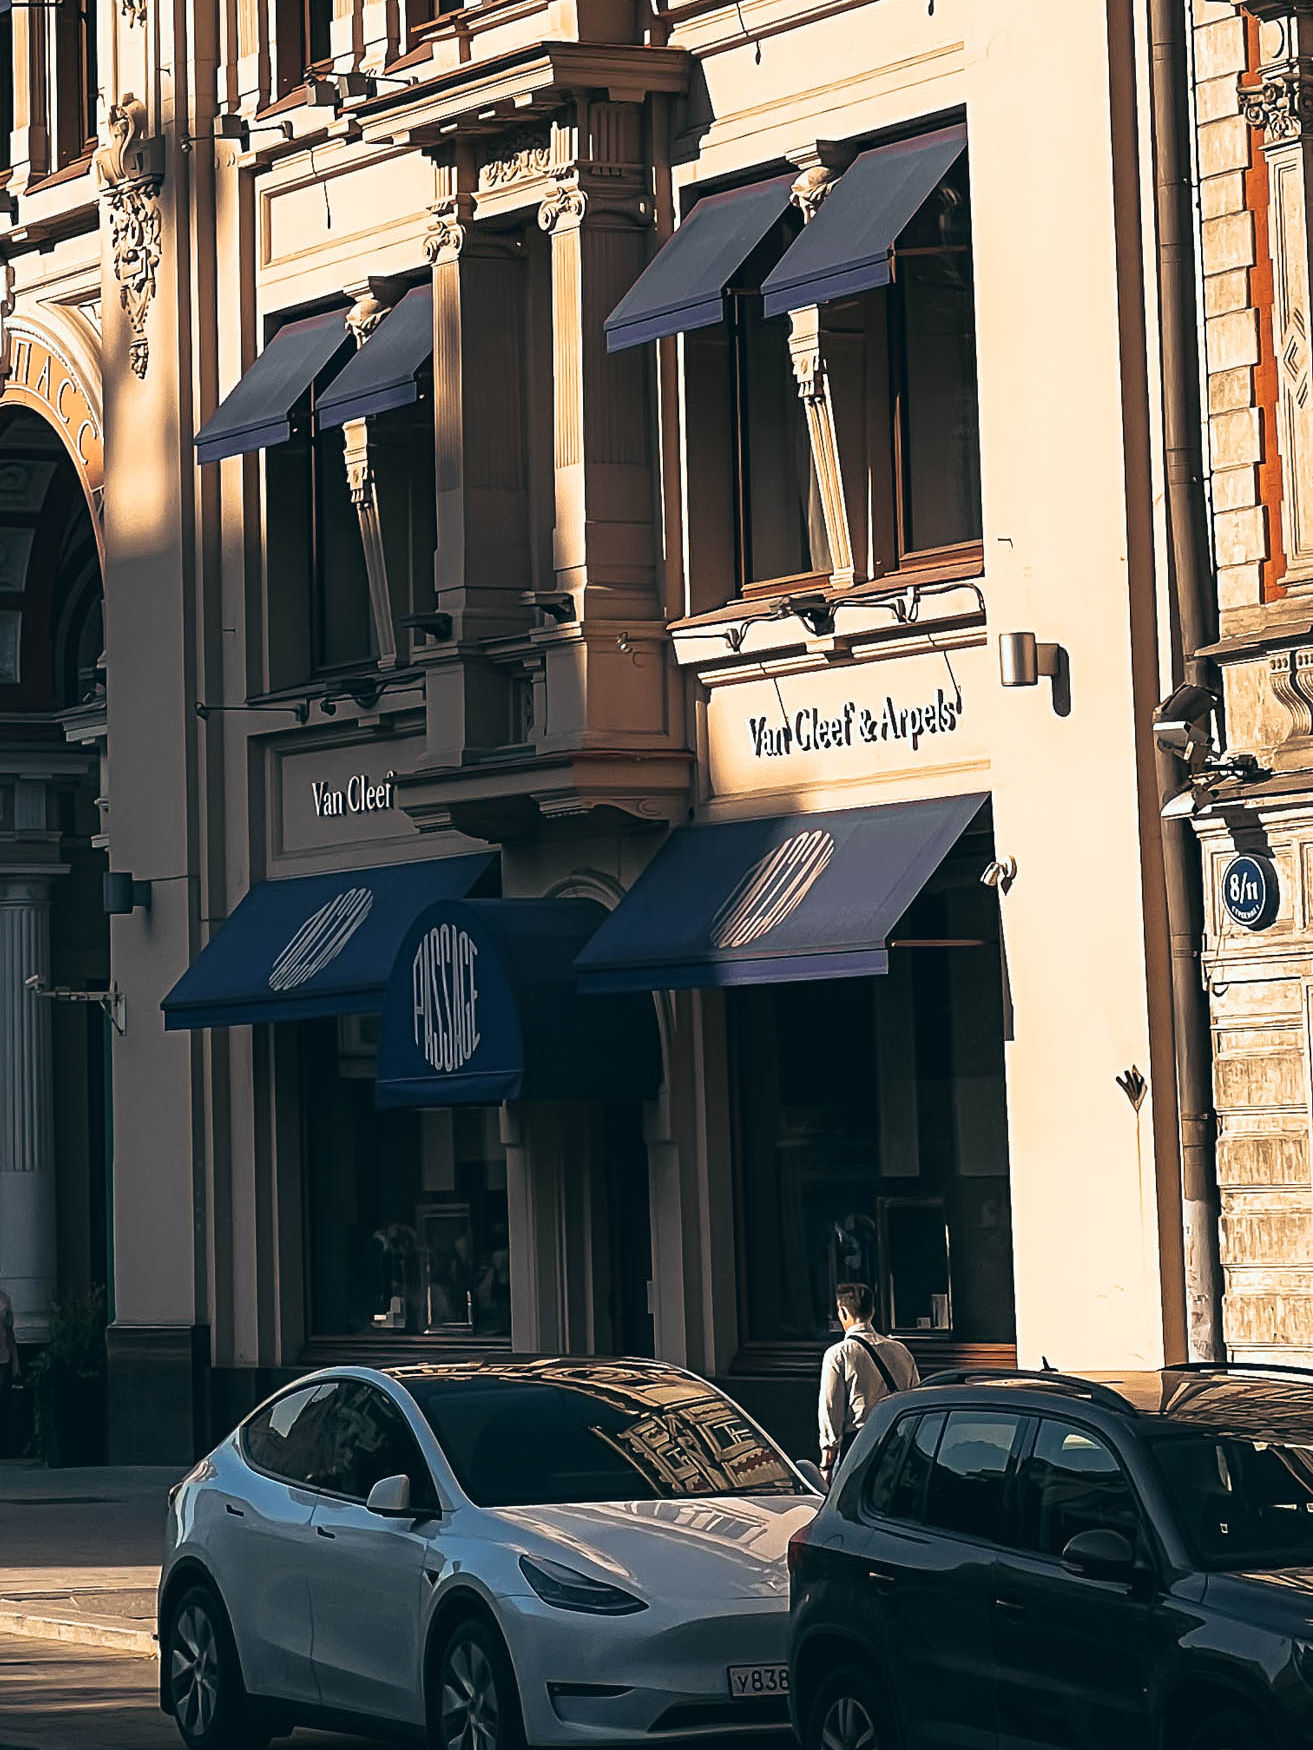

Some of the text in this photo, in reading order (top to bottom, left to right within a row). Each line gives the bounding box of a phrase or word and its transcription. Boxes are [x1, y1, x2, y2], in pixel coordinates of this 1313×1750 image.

[748, 688, 958, 758] Van Cleef & Arpels
[311, 769, 395, 817] Van Cleef
[1229, 871, 1259, 905] 8/11
[412, 922, 481, 1073] PASSAGE
